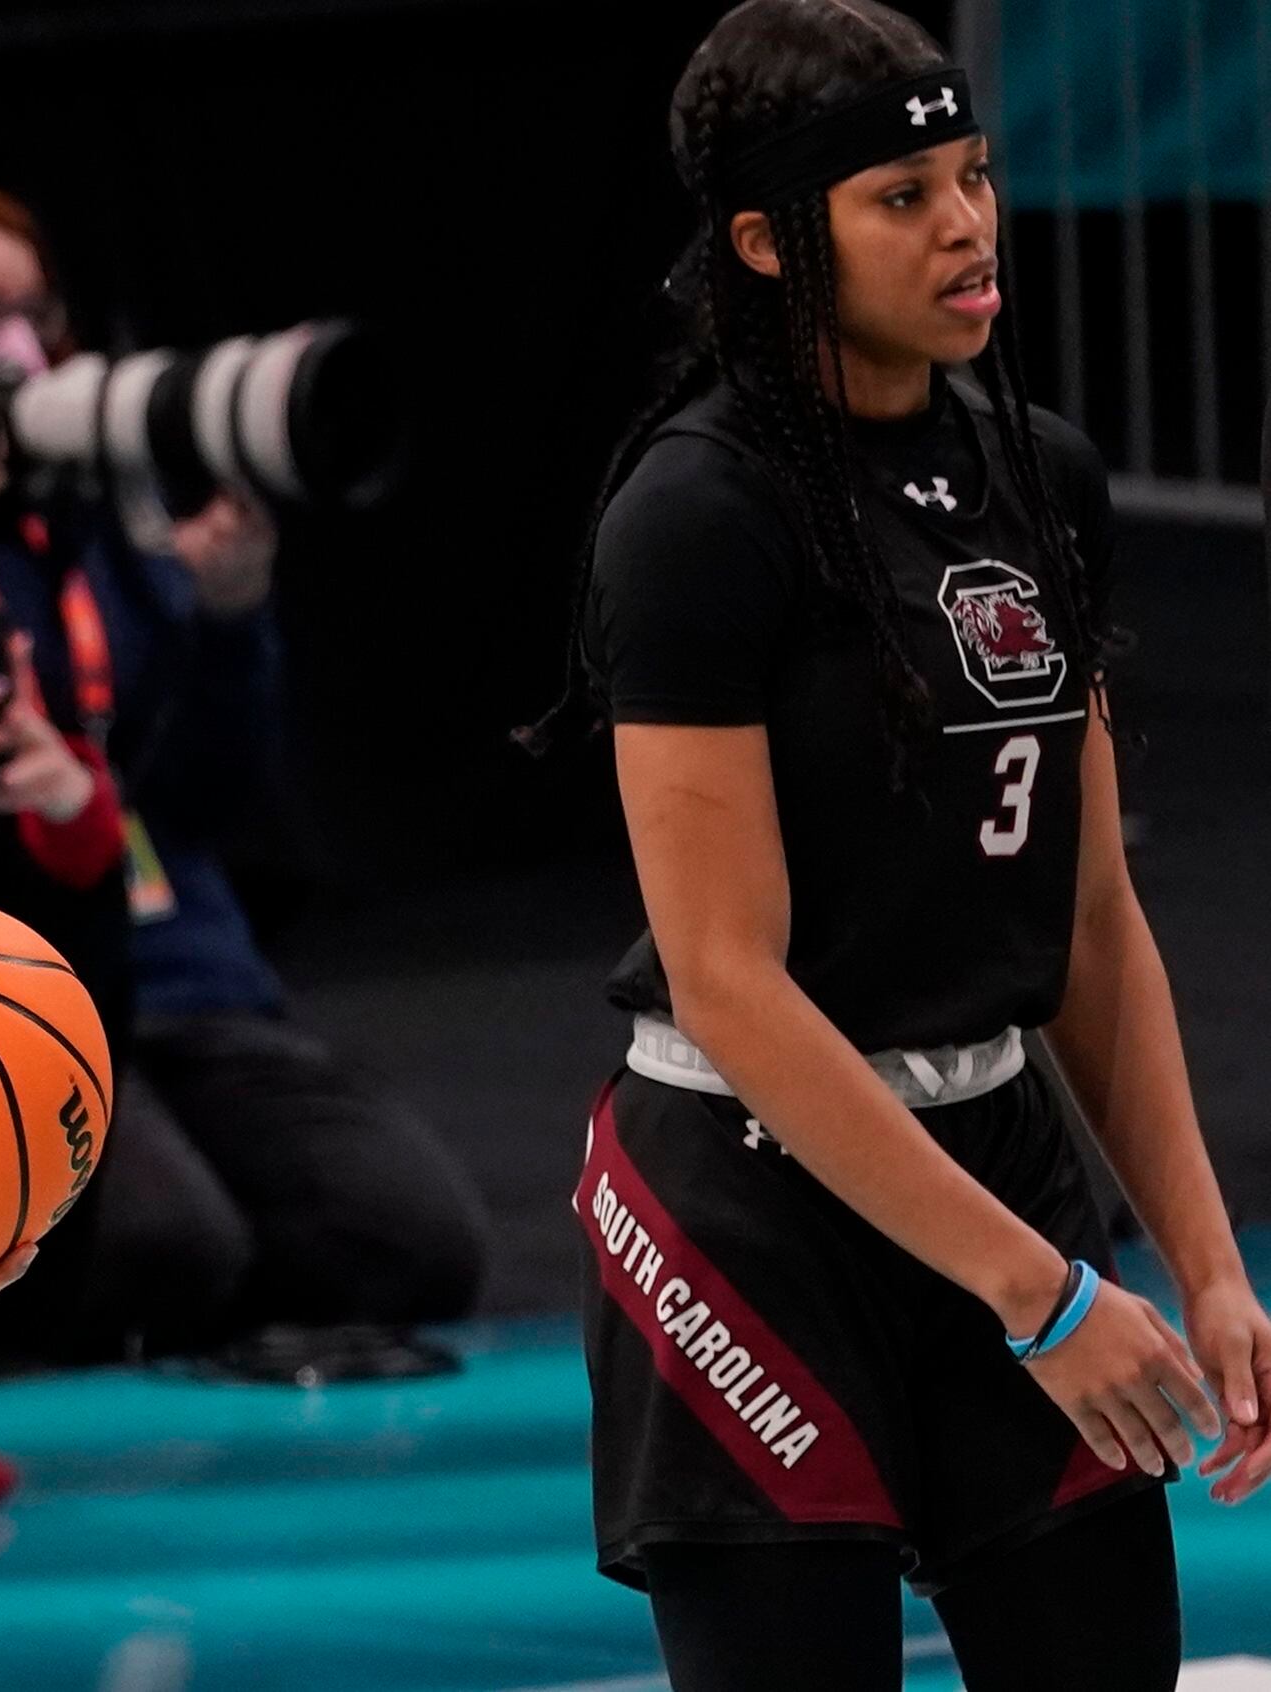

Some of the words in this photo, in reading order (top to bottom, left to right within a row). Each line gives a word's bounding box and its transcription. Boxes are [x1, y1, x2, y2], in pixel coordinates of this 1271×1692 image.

[979, 734, 1041, 856] 3
[592, 1171, 665, 1296] SOUTH
[656, 1276, 820, 1470] CAROLINA
